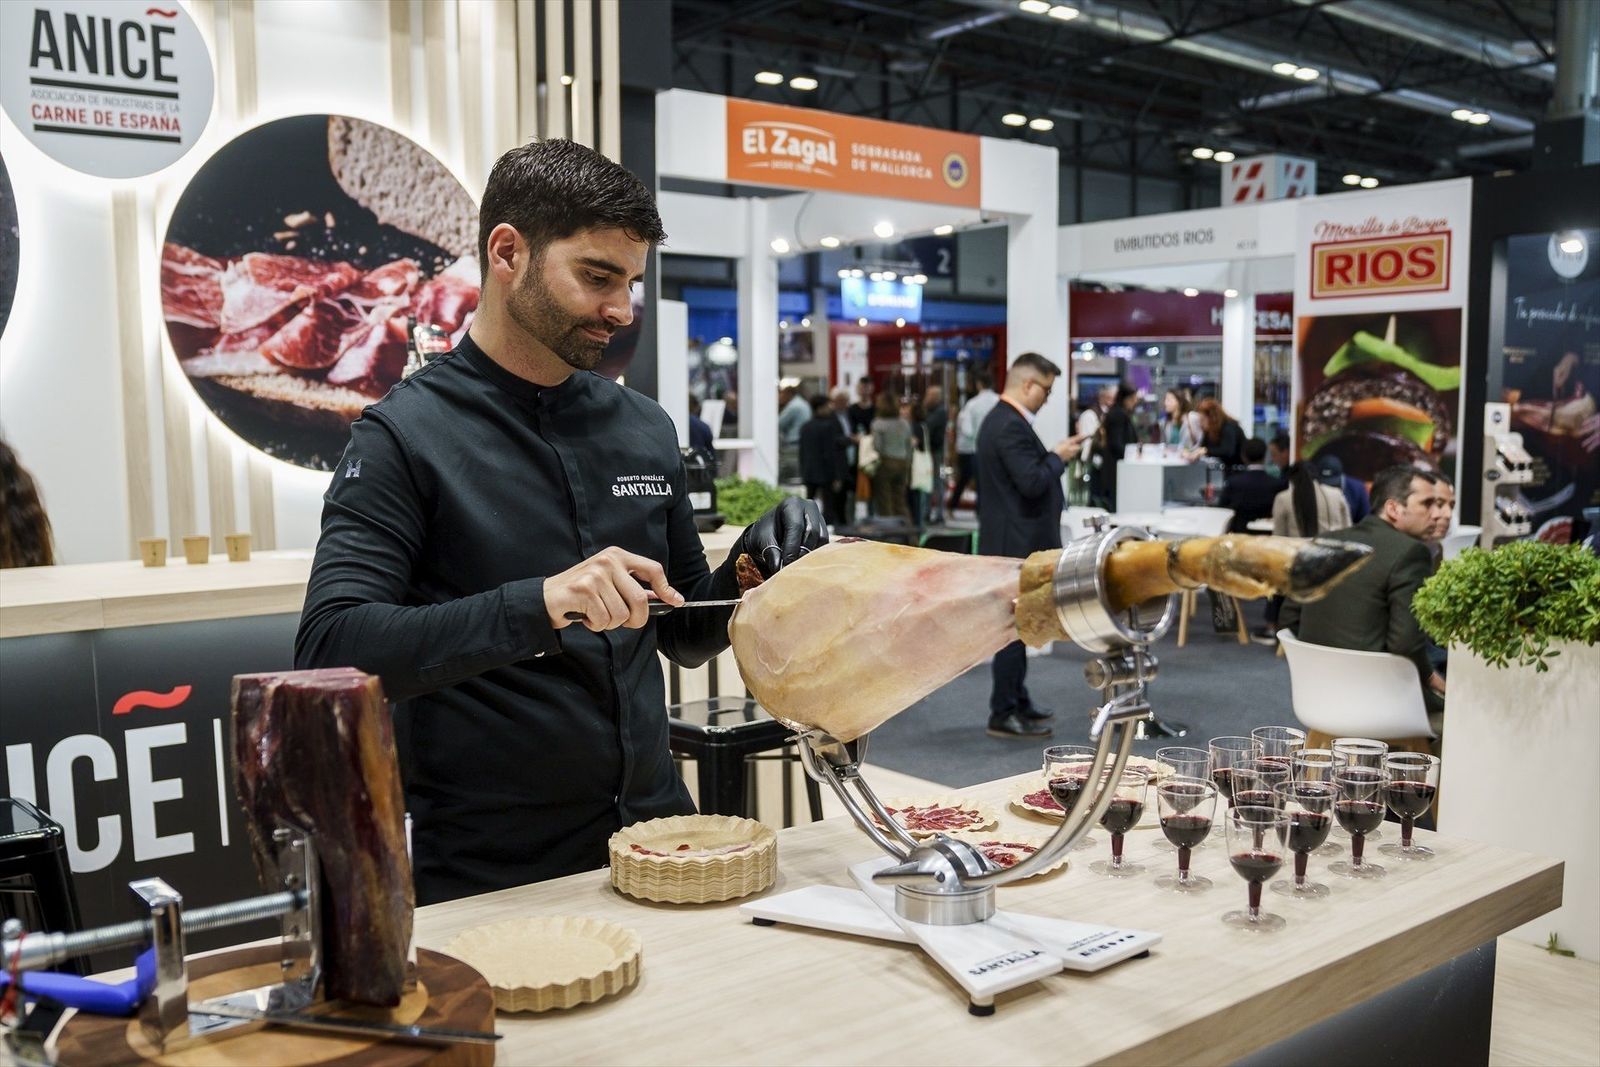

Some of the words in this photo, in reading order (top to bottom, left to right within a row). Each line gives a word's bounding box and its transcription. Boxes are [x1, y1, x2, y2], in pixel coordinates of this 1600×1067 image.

[30, 89, 86, 104] ASOCIACIÓN
[88, 95, 99, 106] DE
[102, 96, 153, 111] INDUSTRIAS
[155, 102, 167, 112] DE
[31, 103, 87, 124] CARNE
[94, 110, 113, 126] DE
[120, 112, 181, 132] ESPAÑA
[742, 127, 767, 155] El
[770, 128, 838, 166] Zagal
[851, 142, 922, 163] SOBRASADA
[851, 158, 867, 172] DE
[870, 160, 933, 180] MALLORCA
[1114, 231, 1179, 252] EMBUTIDOS
[1183, 228, 1214, 246] RIOS
[936, 248, 950, 273] 2
[1326, 246, 1436, 286] RIOS
[1211, 308, 1291, 330] HESA
[612, 483, 672, 496] SANTALLA
